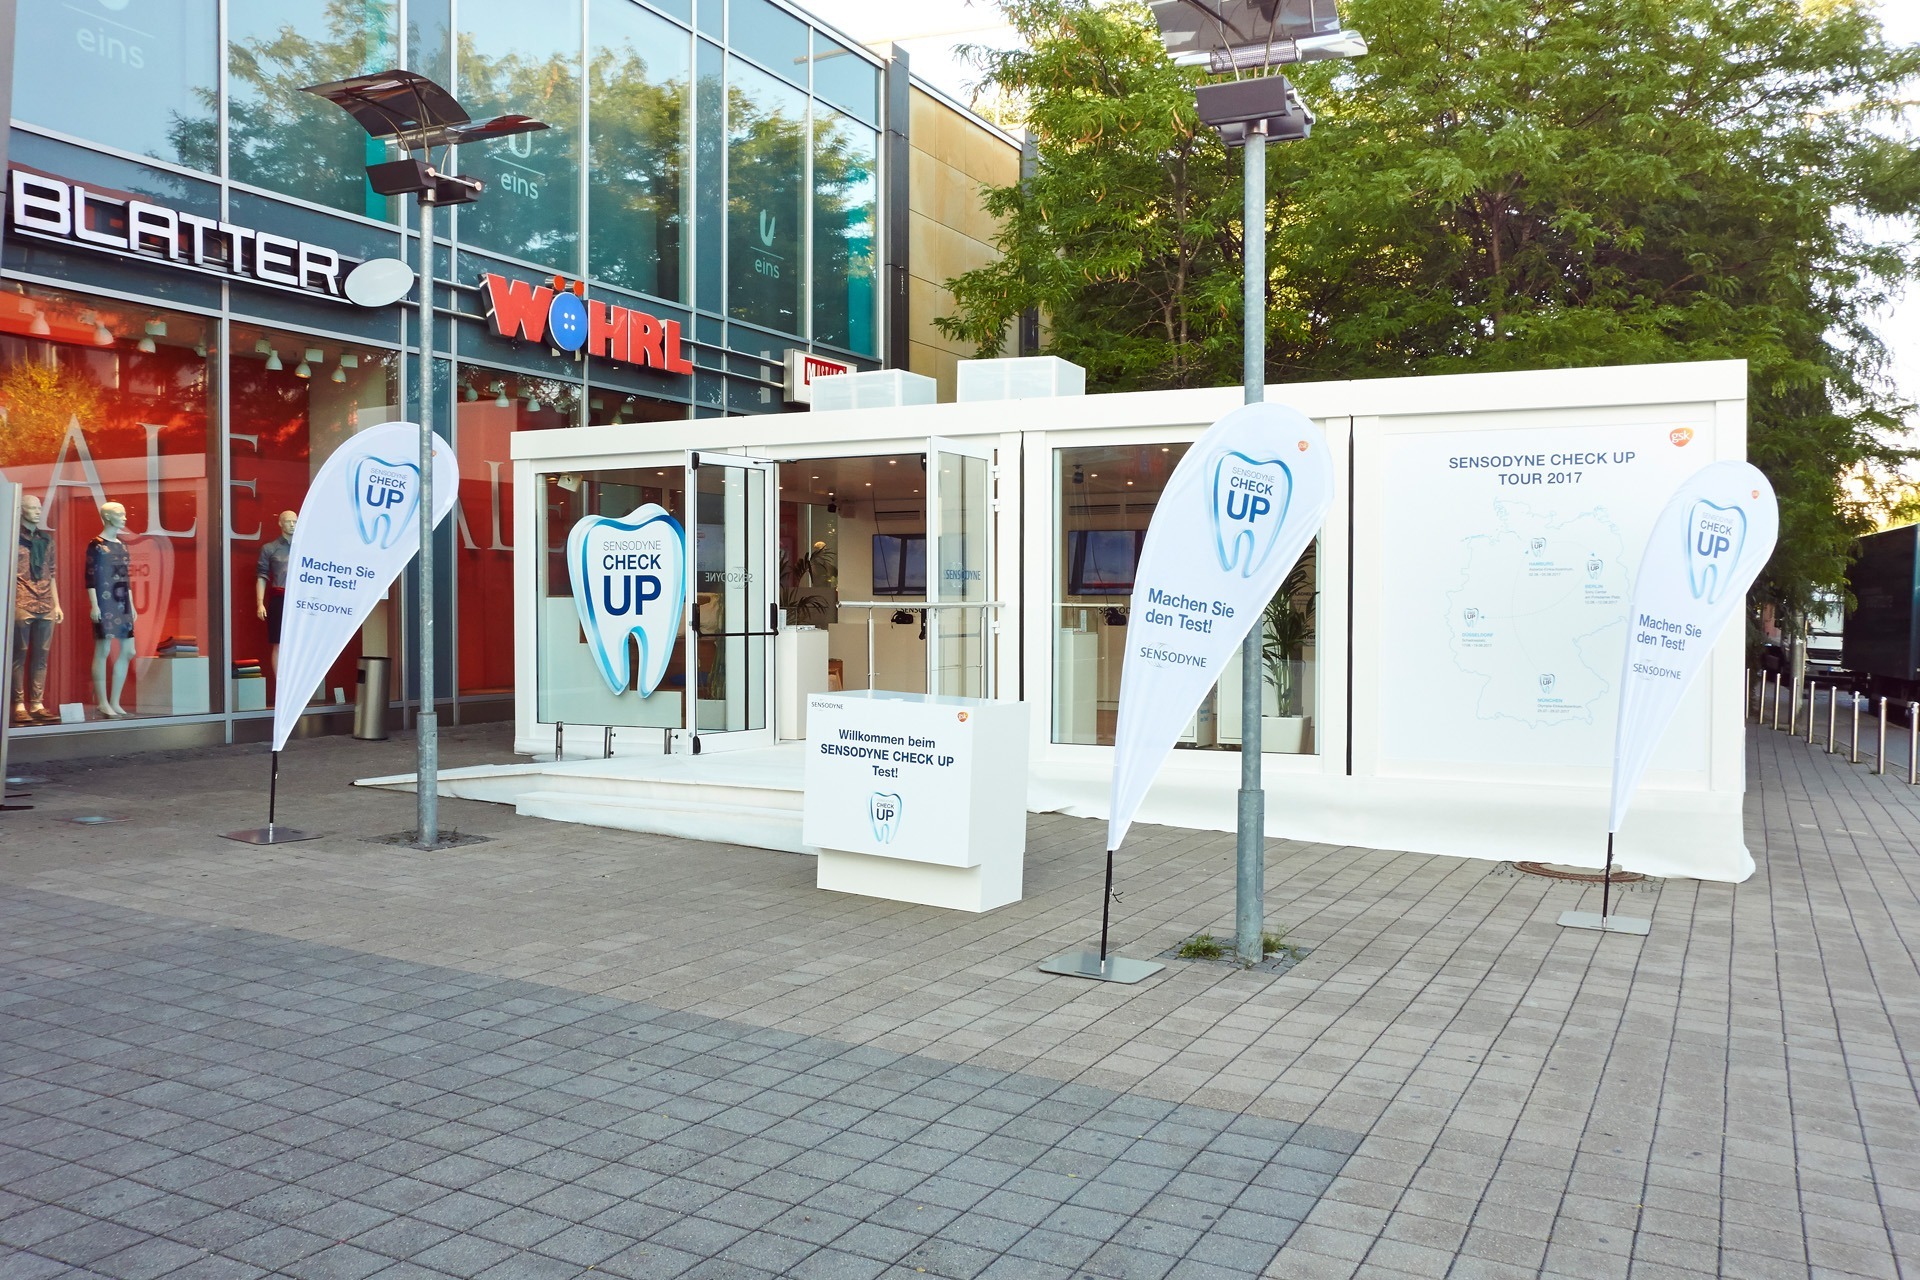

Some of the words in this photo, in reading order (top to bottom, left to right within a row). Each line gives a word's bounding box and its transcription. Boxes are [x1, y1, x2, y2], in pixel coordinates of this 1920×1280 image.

[76, 27, 145, 69] eins
[501, 171, 539, 200] eins
[12, 169, 339, 296] BLATTER
[755, 257, 780, 279] eins
[487, 273, 693, 375] WÖHRL
[1449, 455, 1545, 469] SENSODYNE
[1550, 452, 1607, 466] CHECK
[1613, 451, 1636, 463] UP
[369, 475, 406, 489] CHECK
[371, 467, 407, 481] SENSODYNE
[1232, 466, 1275, 483] SENSODYNE
[1498, 473, 1542, 485] TOUR
[1547, 472, 1582, 484] 2017
[1230, 476, 1273, 496] CHECK
[366, 485, 404, 509] UP
[1226, 490, 1270, 523] UP
[1700, 520, 1732, 536] CHECK
[603, 540, 661, 551] SENSODYNE
[1697, 531, 1730, 558] UP
[301, 557, 352, 576] Machen
[355, 565, 375, 579] Sie
[603, 554, 661, 571] CHECK
[299, 571, 323, 586] den
[327, 576, 357, 590] Test!
[945, 569, 981, 580] SENSODYNE
[603, 575, 662, 616] UP
[1148, 588, 1207, 613] Machen
[1212, 600, 1235, 618] Sie
[296, 600, 353, 616] SENSODYNE
[1145, 608, 1173, 626] den
[1178, 615, 1212, 634] Test!
[1639, 614, 1682, 634] Machen
[1685, 624, 1702, 638] Sie
[1637, 631, 1657, 645] den
[1661, 635, 1685, 651] Test!
[1140, 647, 1207, 668] SENSODYNE
[1633, 663, 1681, 680] SENSODYNE
[811, 702, 843, 710] SENSODYNE
[839, 729, 904, 745] Willkommen
[908, 736, 936, 749] beim
[820, 743, 889, 760] SENSODYNE
[893, 751, 934, 765] CHECK
[938, 756, 954, 767] UP
[872, 765, 898, 778] Test!
[876, 808, 894, 821] UP
